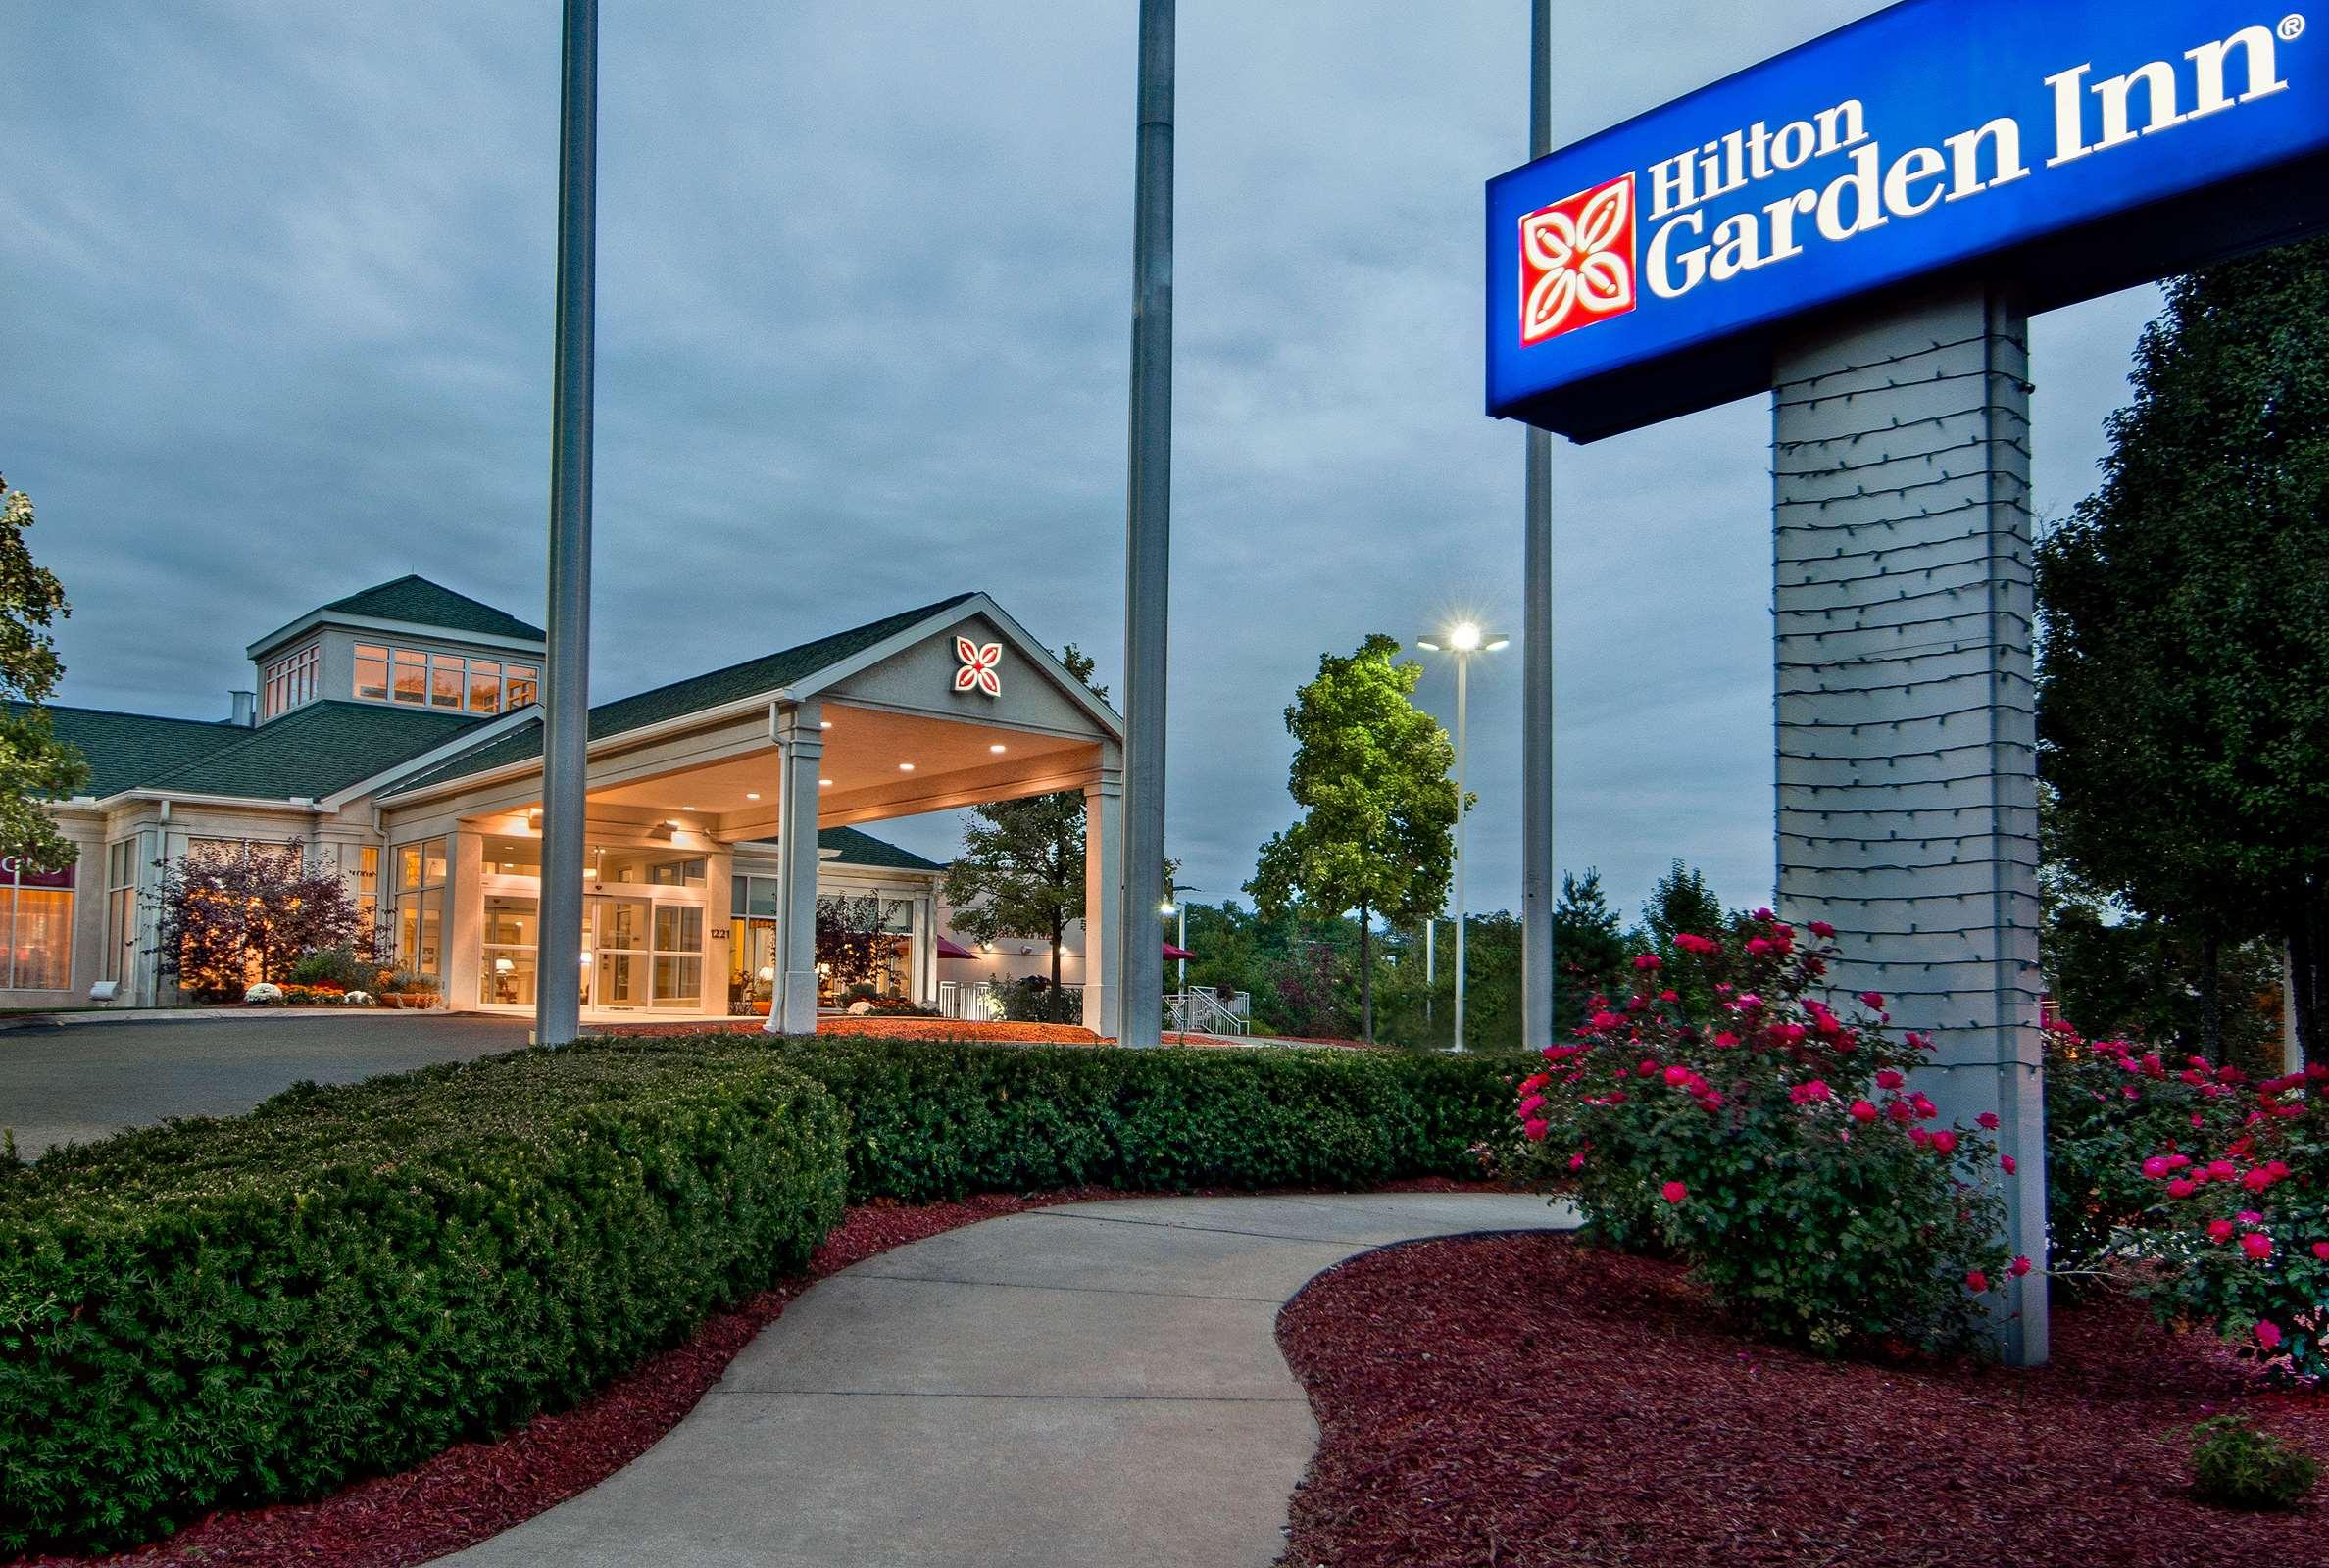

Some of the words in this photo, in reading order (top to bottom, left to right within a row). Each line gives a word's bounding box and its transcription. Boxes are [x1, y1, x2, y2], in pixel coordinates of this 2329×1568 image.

[1645, 116, 2031, 299] Garden
[1647, 98, 1870, 221] Hilton
[711, 928, 730, 939] 1221
